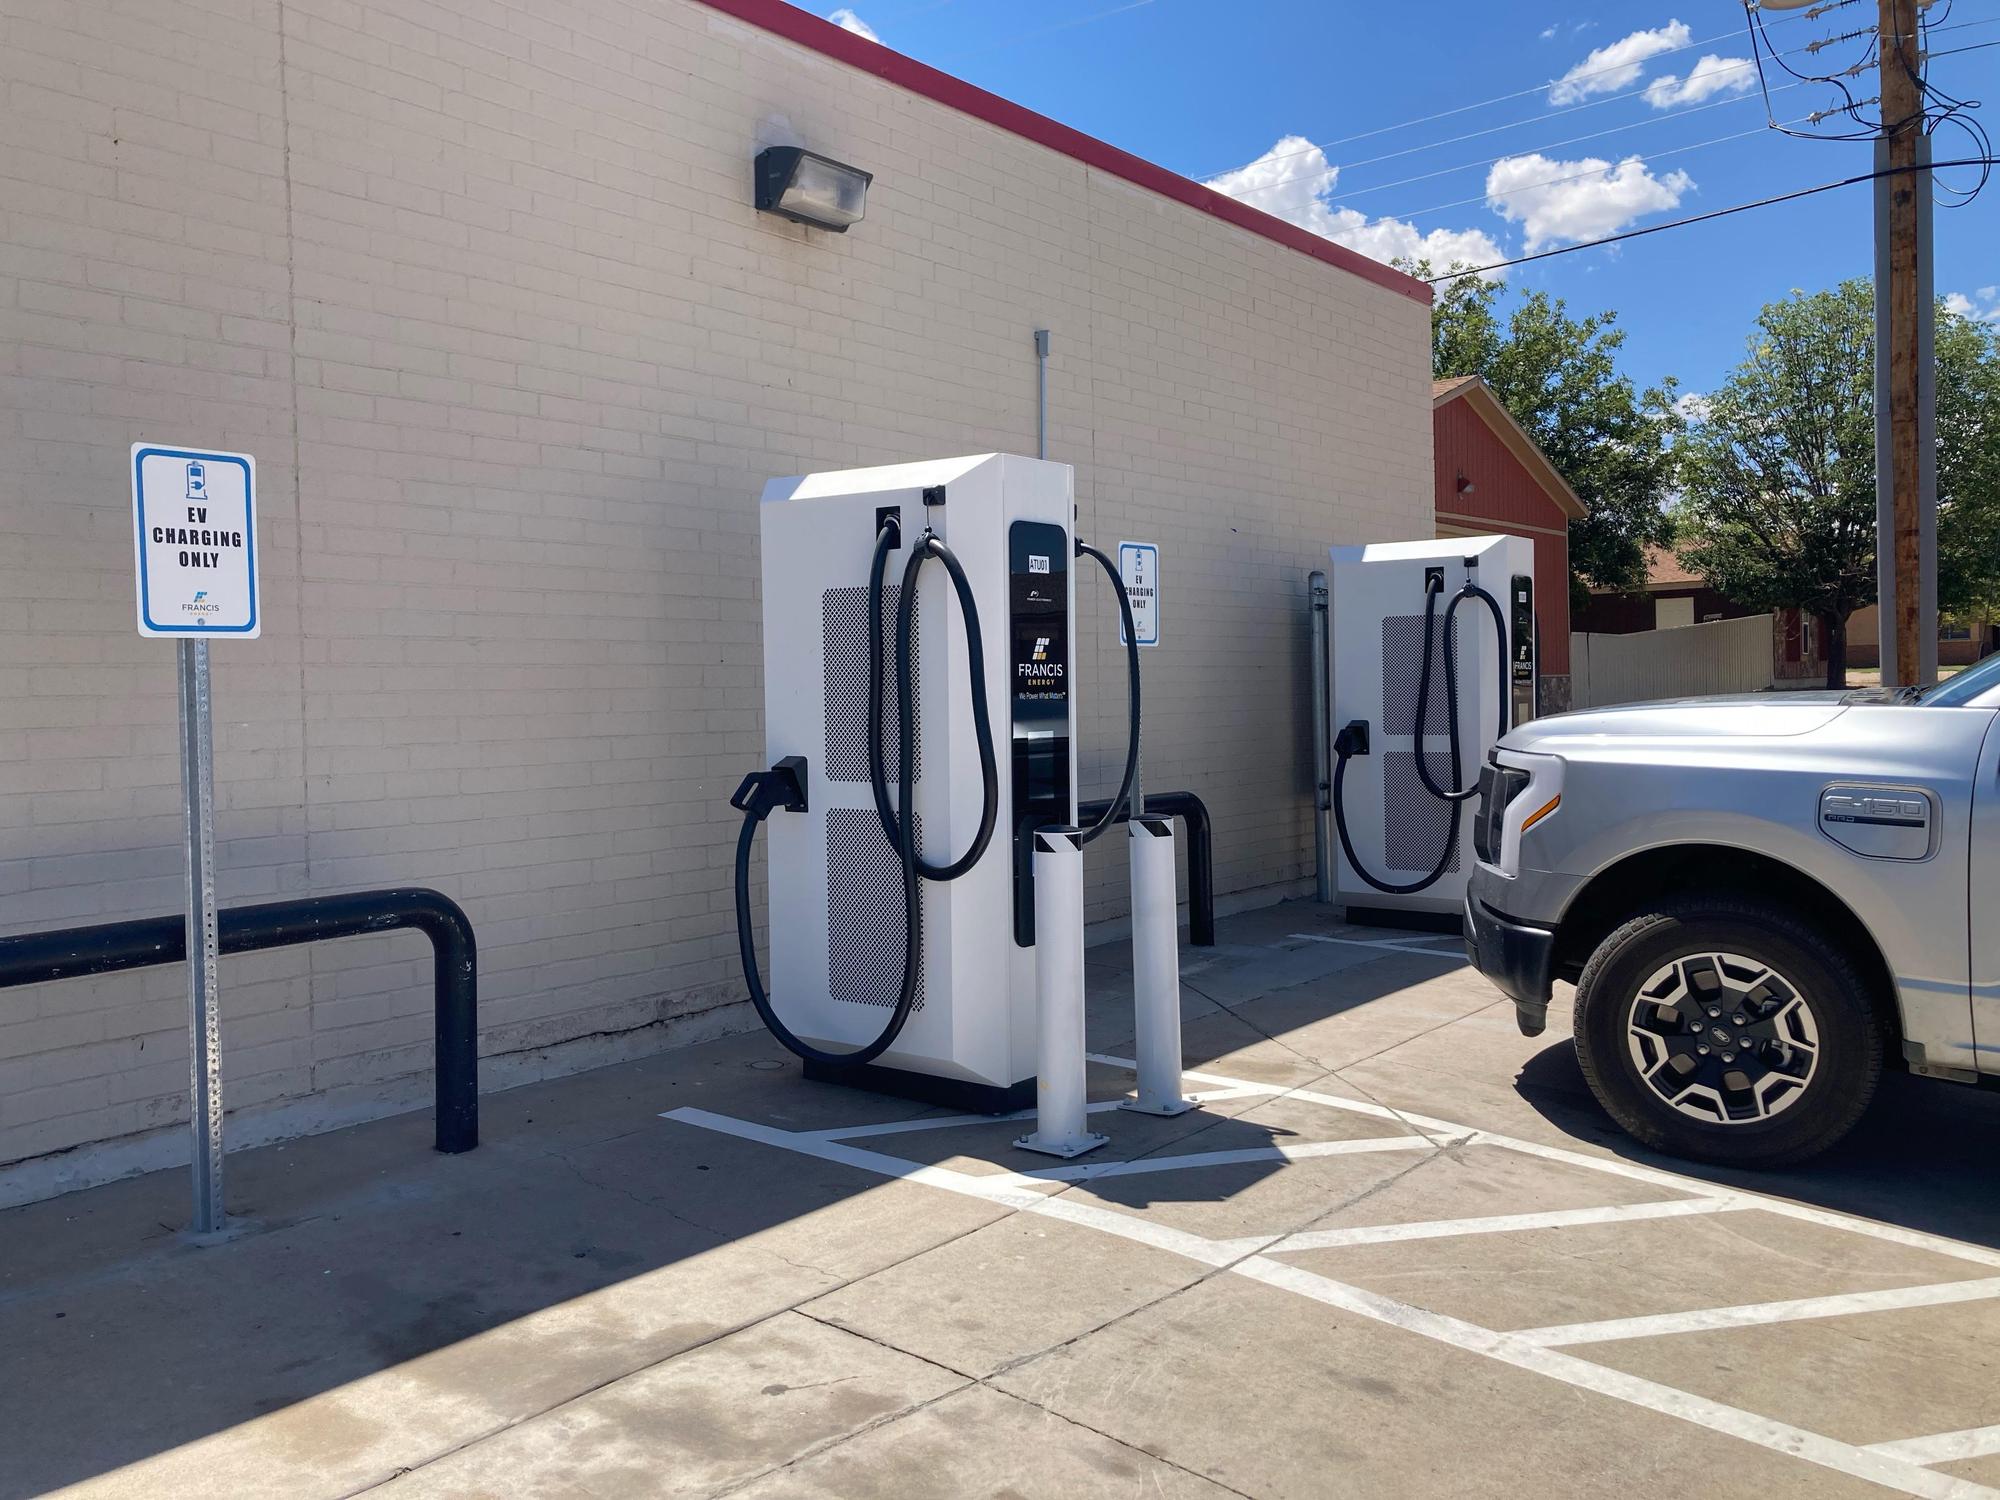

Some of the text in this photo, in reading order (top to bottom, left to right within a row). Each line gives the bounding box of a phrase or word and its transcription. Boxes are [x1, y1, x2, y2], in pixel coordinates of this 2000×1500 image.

[187, 507, 207, 523] EV
[152, 527, 242, 547] CHARGING
[179, 551, 219, 568] ONLY
[1136, 575, 1142, 584] EV
[1125, 586, 1153, 597] CHARGING
[181, 603, 220, 612] FRANCIS
[1132, 600, 1146, 608] ONLY
[1018, 663, 1063, 676] FRANCIS
[1515, 661, 1531, 670] FRANCIS
[1027, 678, 1055, 686] ENERGY
[1019, 692, 1026, 700] We
[1026, 692, 1039, 700] Power
[1825, 796, 1925, 818] F-150
